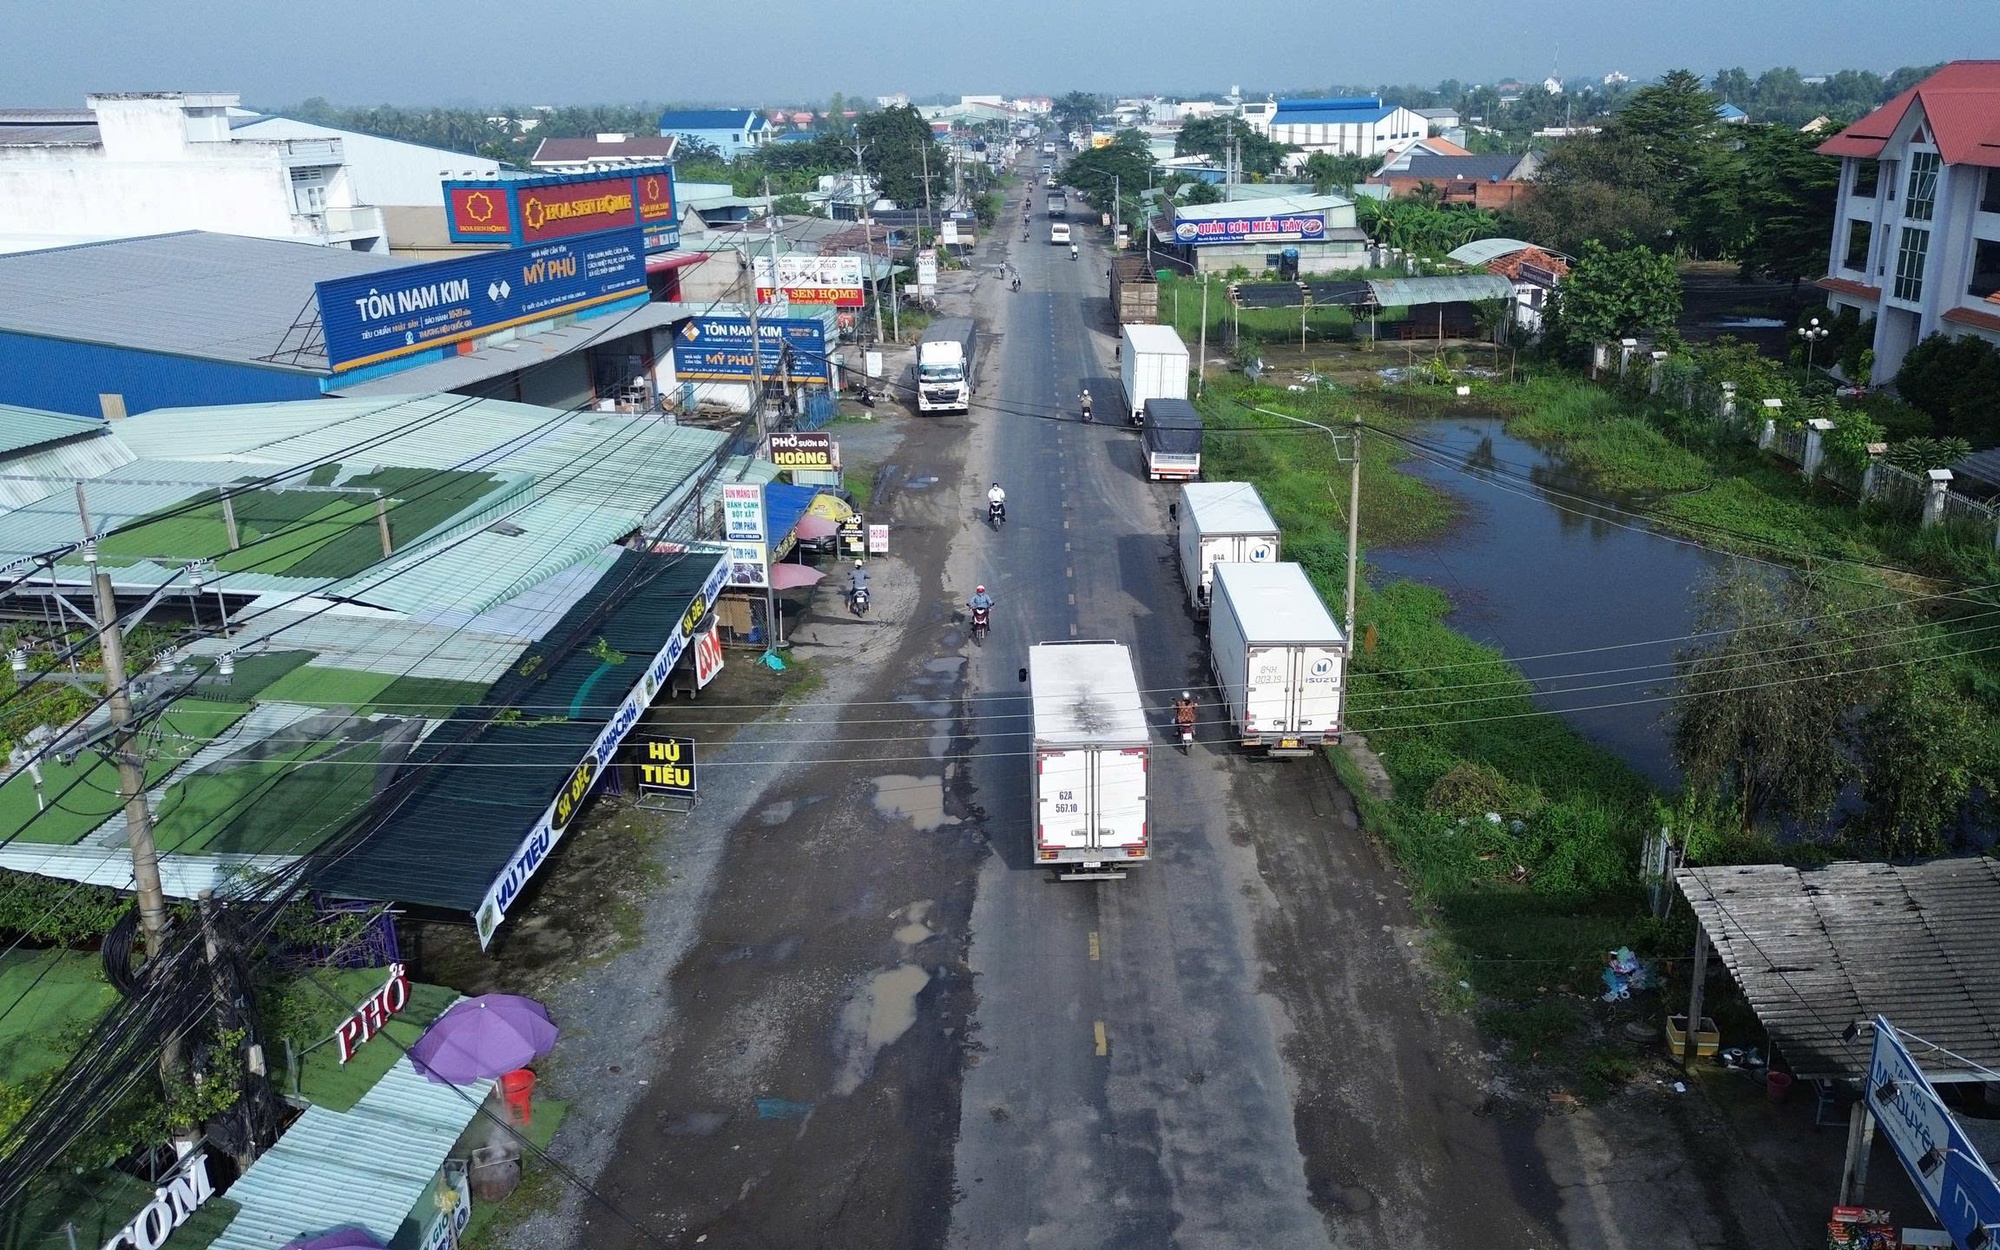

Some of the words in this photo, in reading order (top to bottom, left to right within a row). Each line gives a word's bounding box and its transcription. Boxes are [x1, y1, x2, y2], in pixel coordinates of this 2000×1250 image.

[545, 203, 571, 221] HOA
[572, 199, 598, 217] SEN
[599, 194, 631, 215] HOME
[1197, 220, 1225, 235] QUÁN
[1227, 219, 1250, 233] CƠM
[1281, 217, 1302, 232] TÂY
[523, 258, 545, 286] MỸ
[548, 251, 576, 280] PHÚ
[356, 288, 396, 321] TÔN
[398, 285, 438, 313] NAM
[440, 279, 469, 304] KIM
[791, 289, 815, 299] SEN
[819, 288, 858, 300] HOME
[362, 332, 373, 340] TIÊU
[374, 325, 391, 337] CHUẨN
[703, 322, 728, 336] TÔN
[760, 325, 782, 337] KIM
[705, 352, 725, 365] MỸ
[727, 353, 754, 366] PHÚ
[771, 434, 797, 448] PHỞ
[798, 439, 817, 448] SƯỜN
[818, 439, 829, 447] BÒ
[774, 448, 827, 465] HOÀNG
[1213, 553, 1225, 561] 84A
[649, 739, 680, 761] HỦ
[641, 762, 690, 786] TIẾU
[1059, 791, 1073, 800] 62A
[1055, 804, 1078, 813] 567.10
[495, 867, 518, 915] HỦ
[517, 826, 550, 881] TIẾU
[559, 793, 571, 824] SA
[335, 962, 407, 1064] PHỞ
